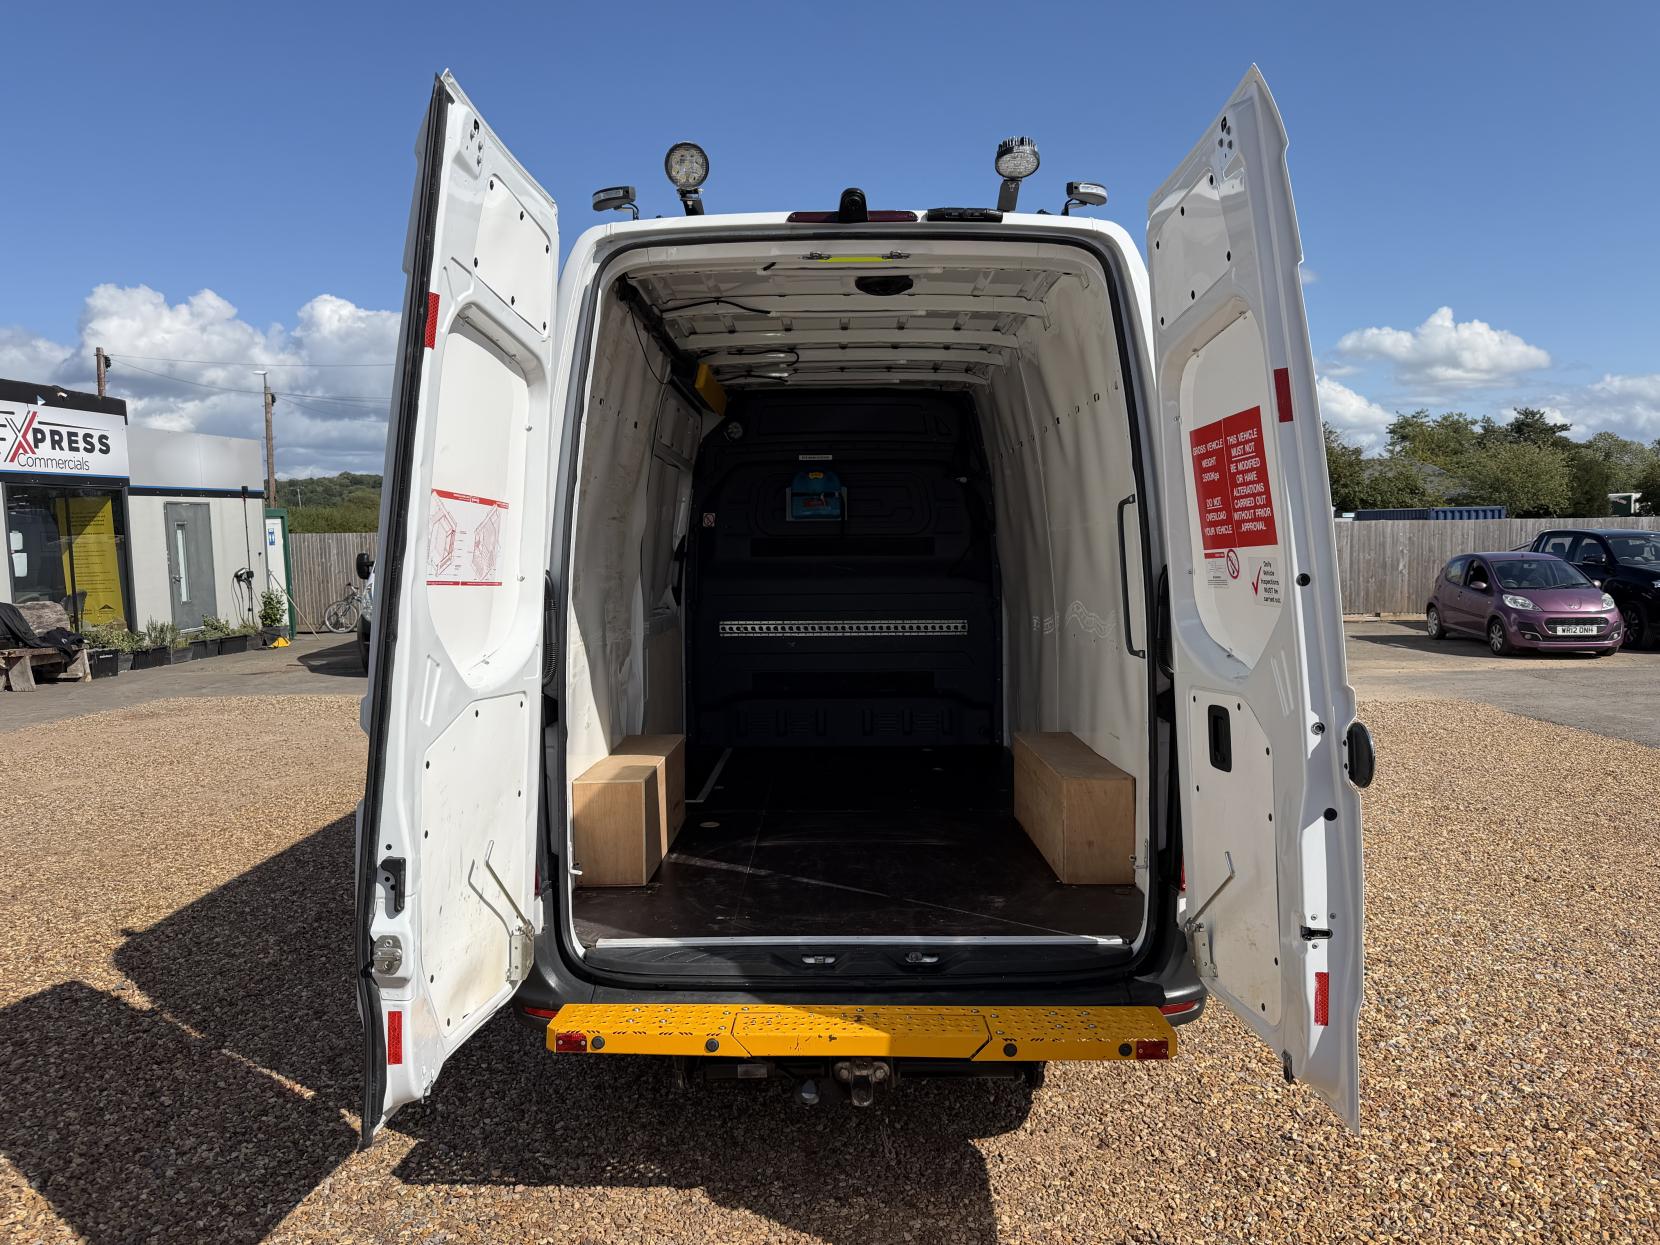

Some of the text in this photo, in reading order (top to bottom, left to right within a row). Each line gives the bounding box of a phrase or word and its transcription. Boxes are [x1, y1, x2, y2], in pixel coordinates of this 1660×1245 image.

[1227, 429, 1257, 445] THIS VEHICLE
[1193, 439, 1223, 455] GROSS VEHICLE
[1231, 442, 1255, 456] MUST NOT
[17, 453, 90, 471] Commercials
[1202, 457, 1216, 468] WEIGHT
[1230, 458, 1260, 473] BE MODIFIED
[1236, 471, 1257, 484] OR HAVE
[1233, 483, 1264, 497] ALTERATIONS
[1206, 497, 1222, 507] DO NOT
[1234, 495, 1266, 509] CARRIED OUT
[1206, 510, 1227, 522] OVERLOAD
[1234, 507, 1271, 521] WITHOUT PRIOR
[1205, 525, 1232, 536] YOUR VEHICLE
